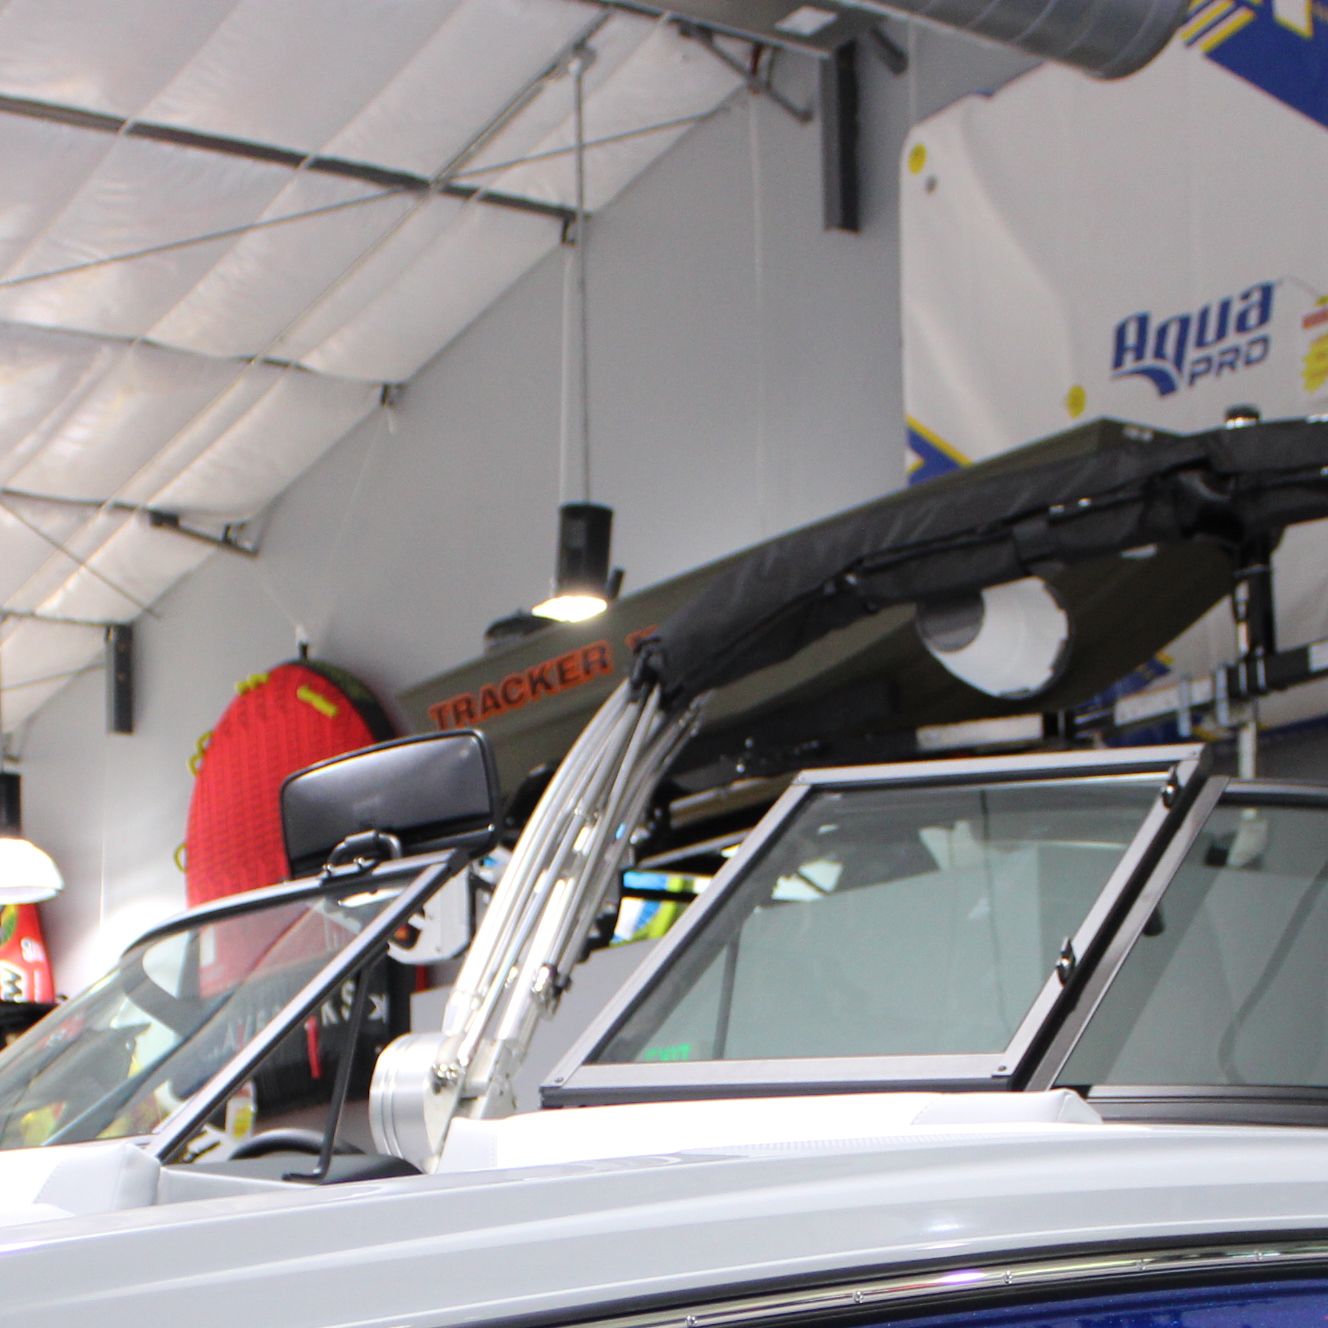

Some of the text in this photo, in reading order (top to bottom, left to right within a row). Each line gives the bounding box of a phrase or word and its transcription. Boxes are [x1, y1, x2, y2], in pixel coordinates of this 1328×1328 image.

[1112, 280, 1275, 398] Aqua
[1186, 334, 1270, 388] PRO
[428, 640, 613, 730] TRACKER
